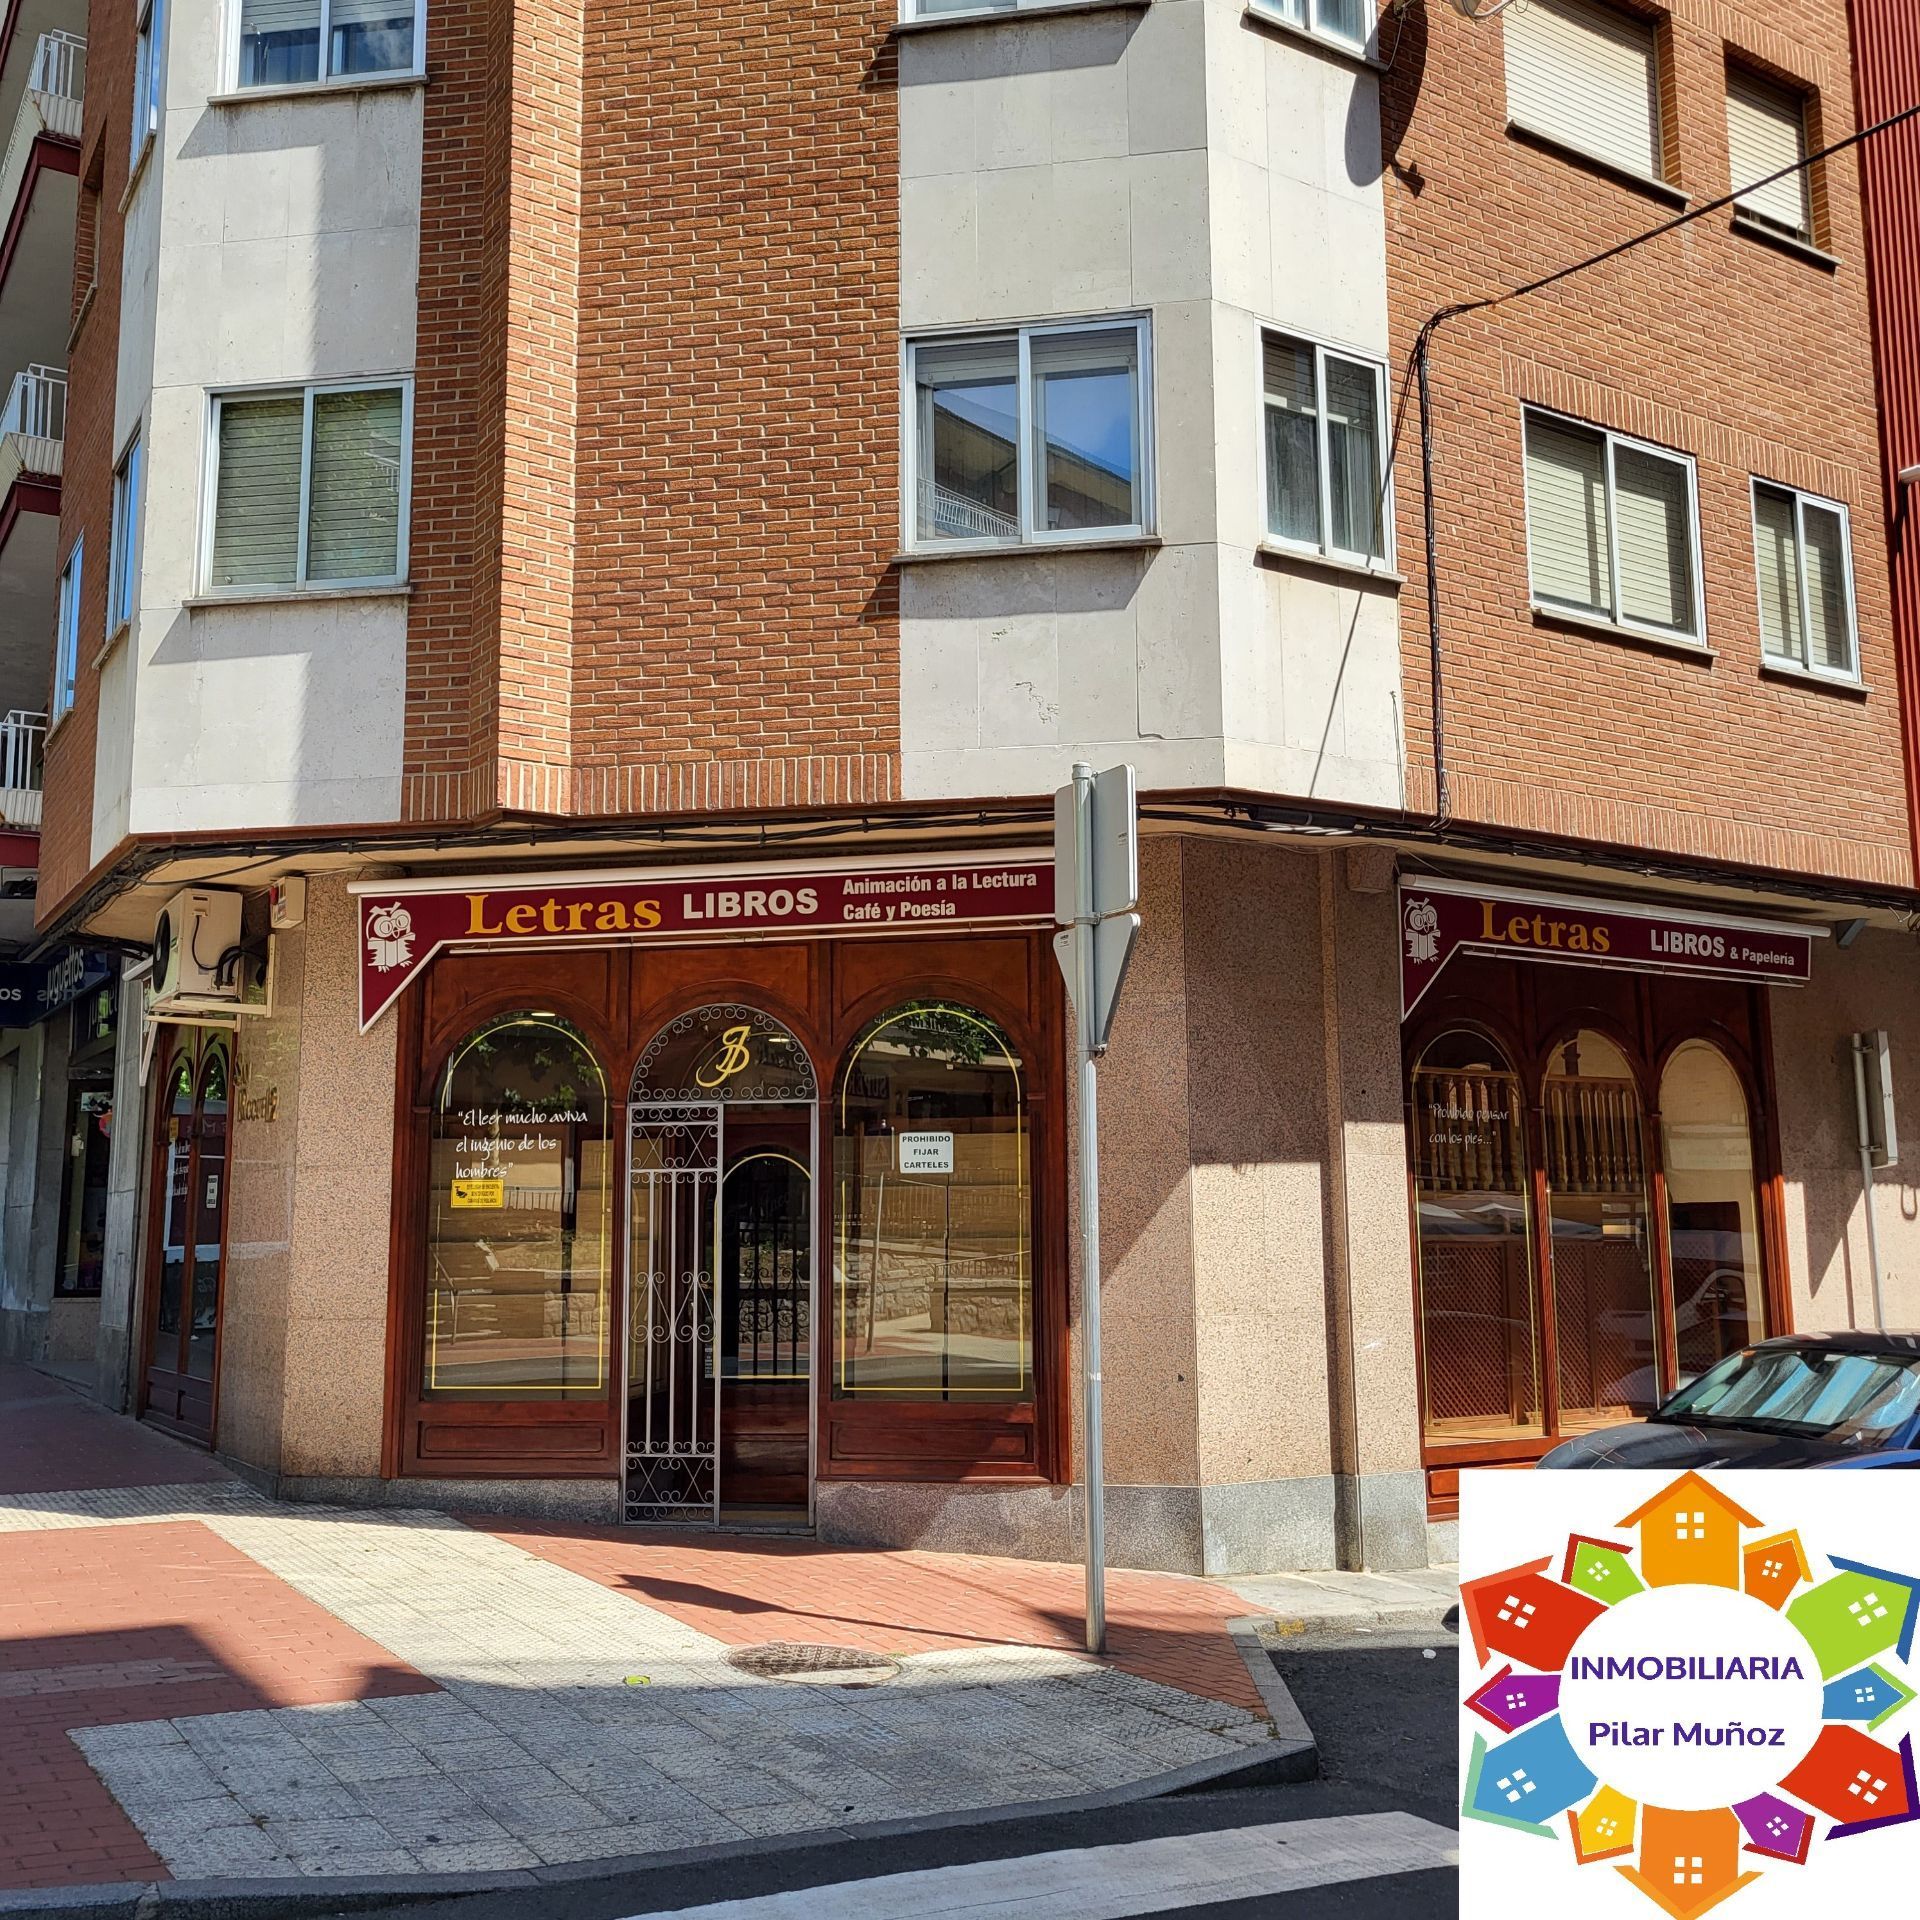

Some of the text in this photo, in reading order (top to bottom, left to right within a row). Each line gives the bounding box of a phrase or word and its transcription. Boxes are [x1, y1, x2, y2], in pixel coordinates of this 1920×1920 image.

[842, 871, 1037, 896] Animación a la Lectura
[465, 888, 819, 934] Letras LIBROS
[843, 900, 956, 920] Café y Poesía
[1479, 900, 1795, 966] Letras LIBROS & Papelería
[478, 1109, 502, 1126] leer
[505, 1107, 547, 1125] mucho
[549, 1110, 588, 1123] aviva
[456, 1133, 557, 1161] el ingenio de los
[902, 1135, 951, 1143] PROHIBIDO
[913, 1148, 939, 1156] FIJAR
[904, 1161, 949, 1169] CARTELES
